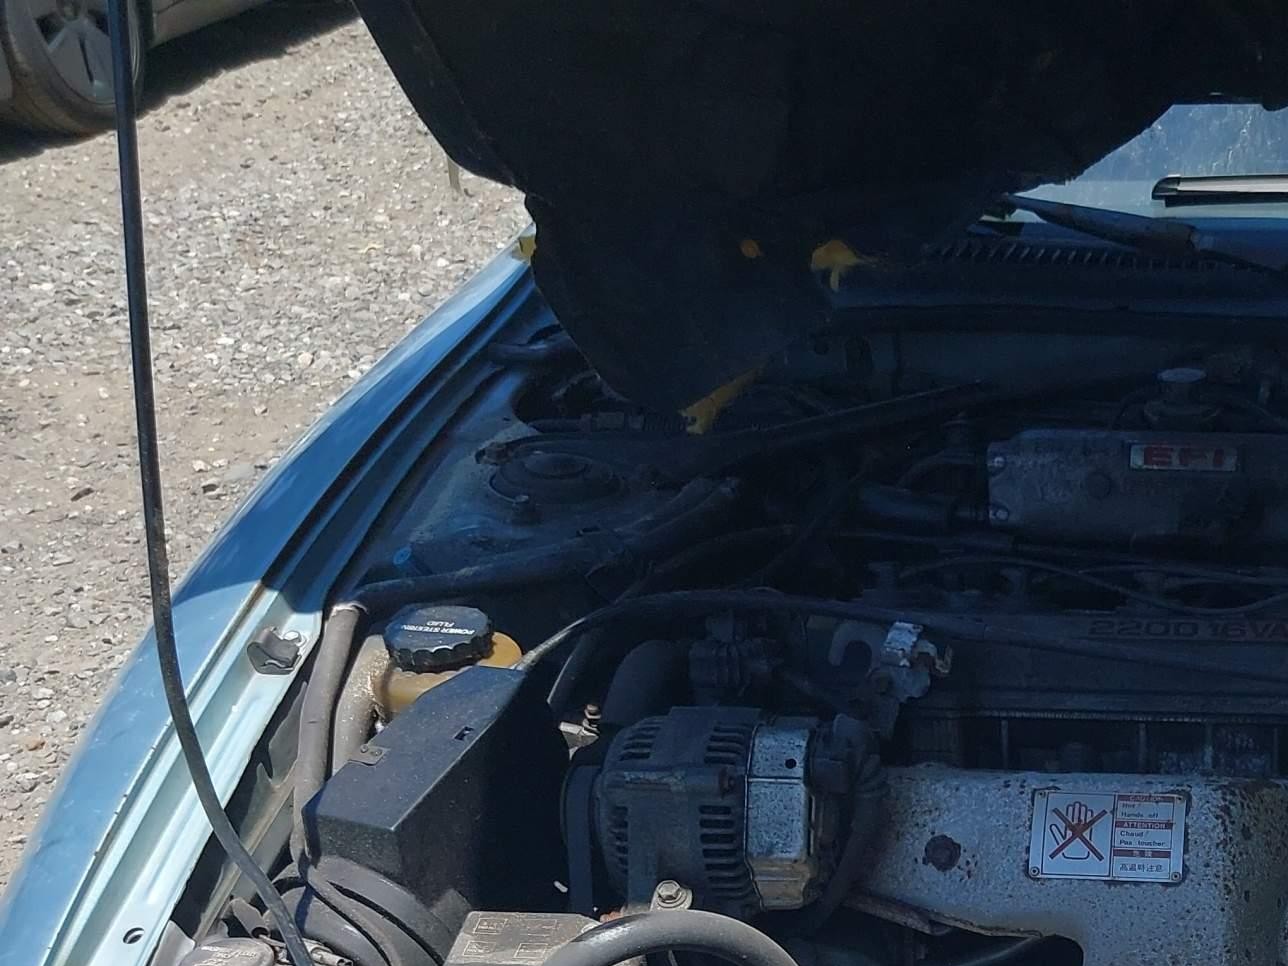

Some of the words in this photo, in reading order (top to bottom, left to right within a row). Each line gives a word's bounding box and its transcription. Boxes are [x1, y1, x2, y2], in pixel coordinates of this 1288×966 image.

[1144, 446, 1224, 467] EFI
[426, 620, 455, 628] FLUID
[440, 627, 475, 635] POWER
[1088, 619, 1199, 638] 2200
[1123, 821, 1166, 829] ATTENTION
